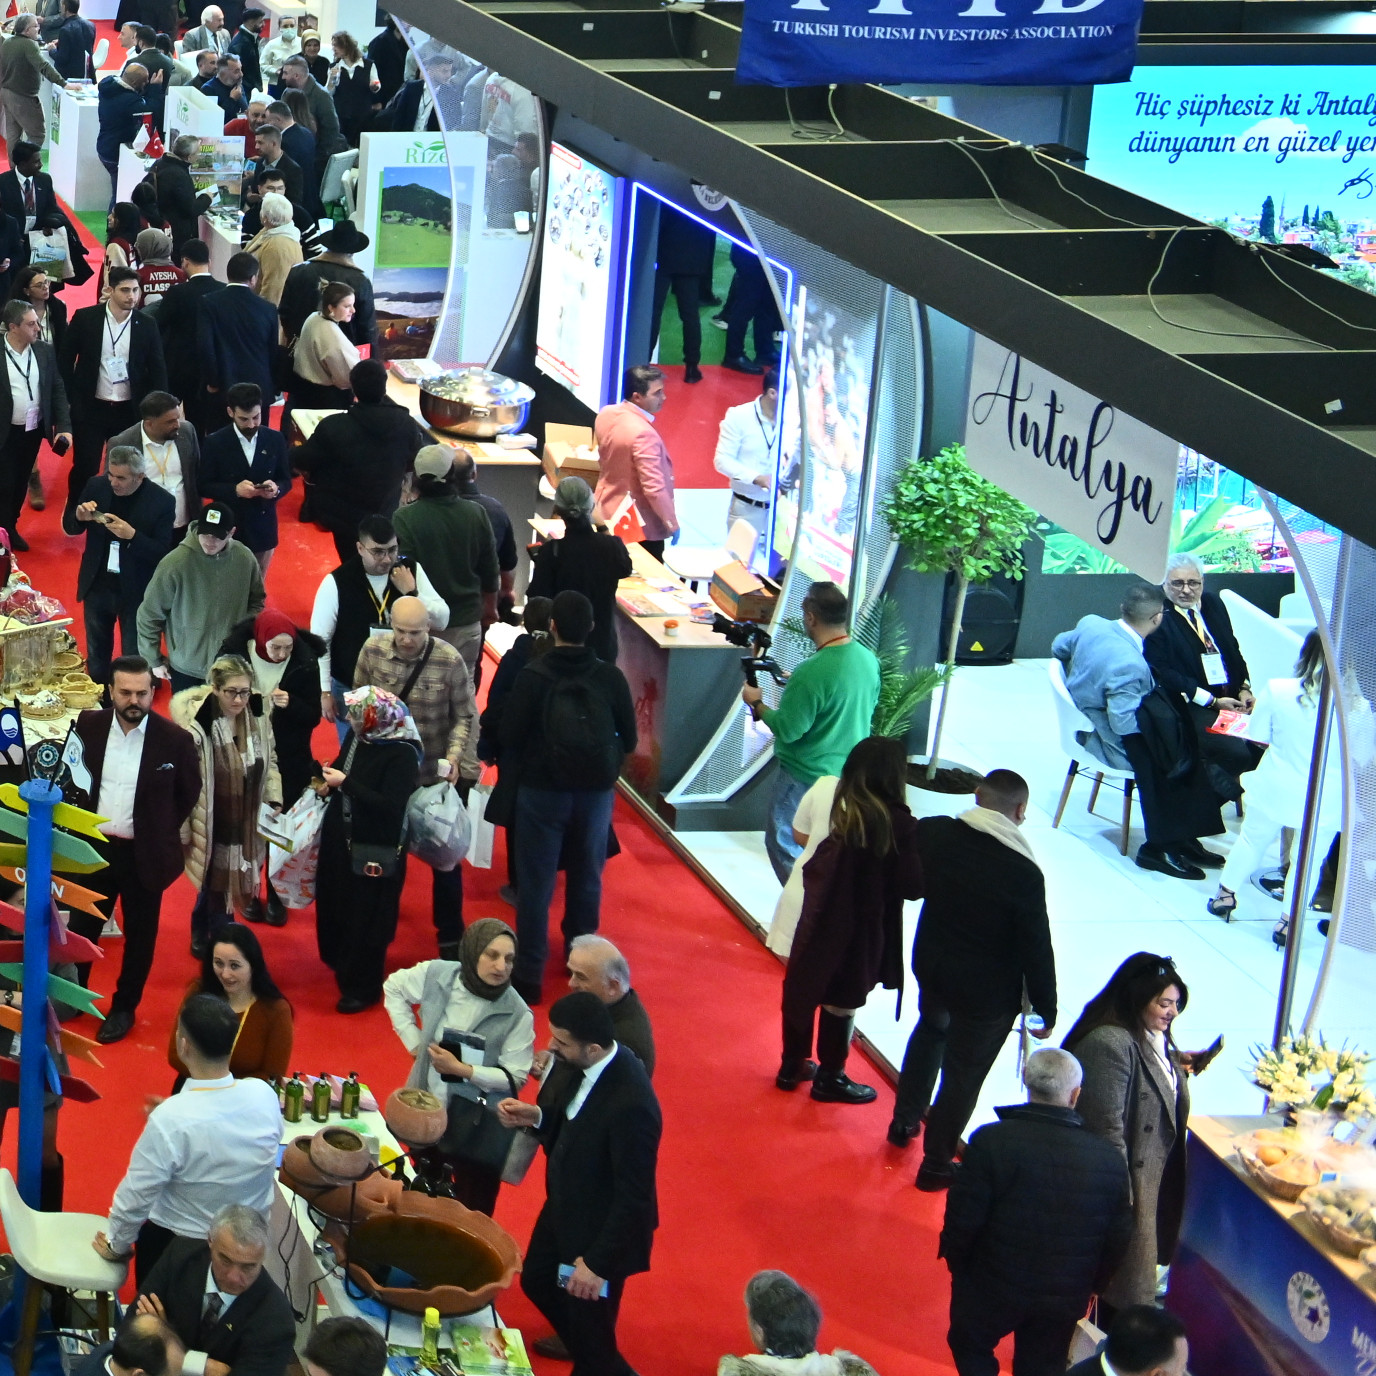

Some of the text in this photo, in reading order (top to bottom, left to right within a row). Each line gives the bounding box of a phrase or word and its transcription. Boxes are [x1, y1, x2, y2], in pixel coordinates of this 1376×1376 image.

[773, 20, 1114, 41] TURKISH TOURISM INVESTORS ASSOCIATION
[1134, 92, 1171, 120] Hiç
[1177, 93, 1273, 127] şüphesiz
[1283, 94, 1303, 116] ki
[1129, 134, 1236, 164] dünyanın
[1244, 136, 1269, 153] en
[1278, 130, 1341, 164] güzel
[149, 272, 177, 281] AYESHA
